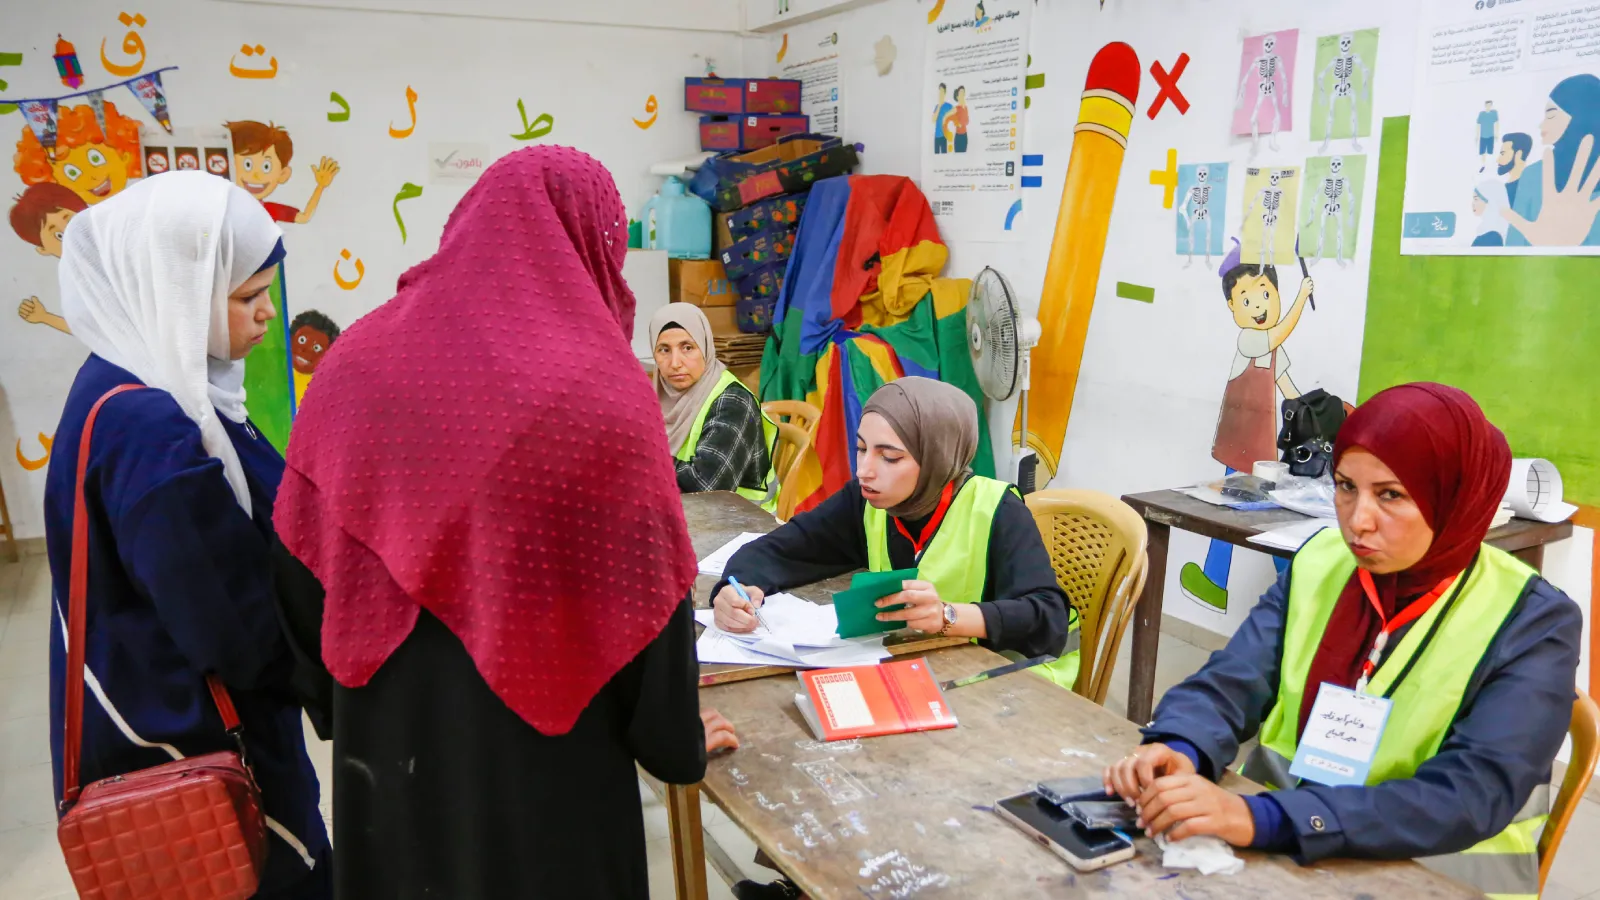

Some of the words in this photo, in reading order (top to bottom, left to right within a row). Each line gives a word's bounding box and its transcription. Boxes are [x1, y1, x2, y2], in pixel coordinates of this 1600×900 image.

[99, 11, 148, 78] ق
[228, 43, 279, 79] ت
[327, 91, 351, 123] د
[387, 85, 419, 139] ل
[511, 98, 555, 141] ط
[632, 94, 659, 131] و
[392, 182, 424, 243] م
[332, 247, 366, 291] ن
